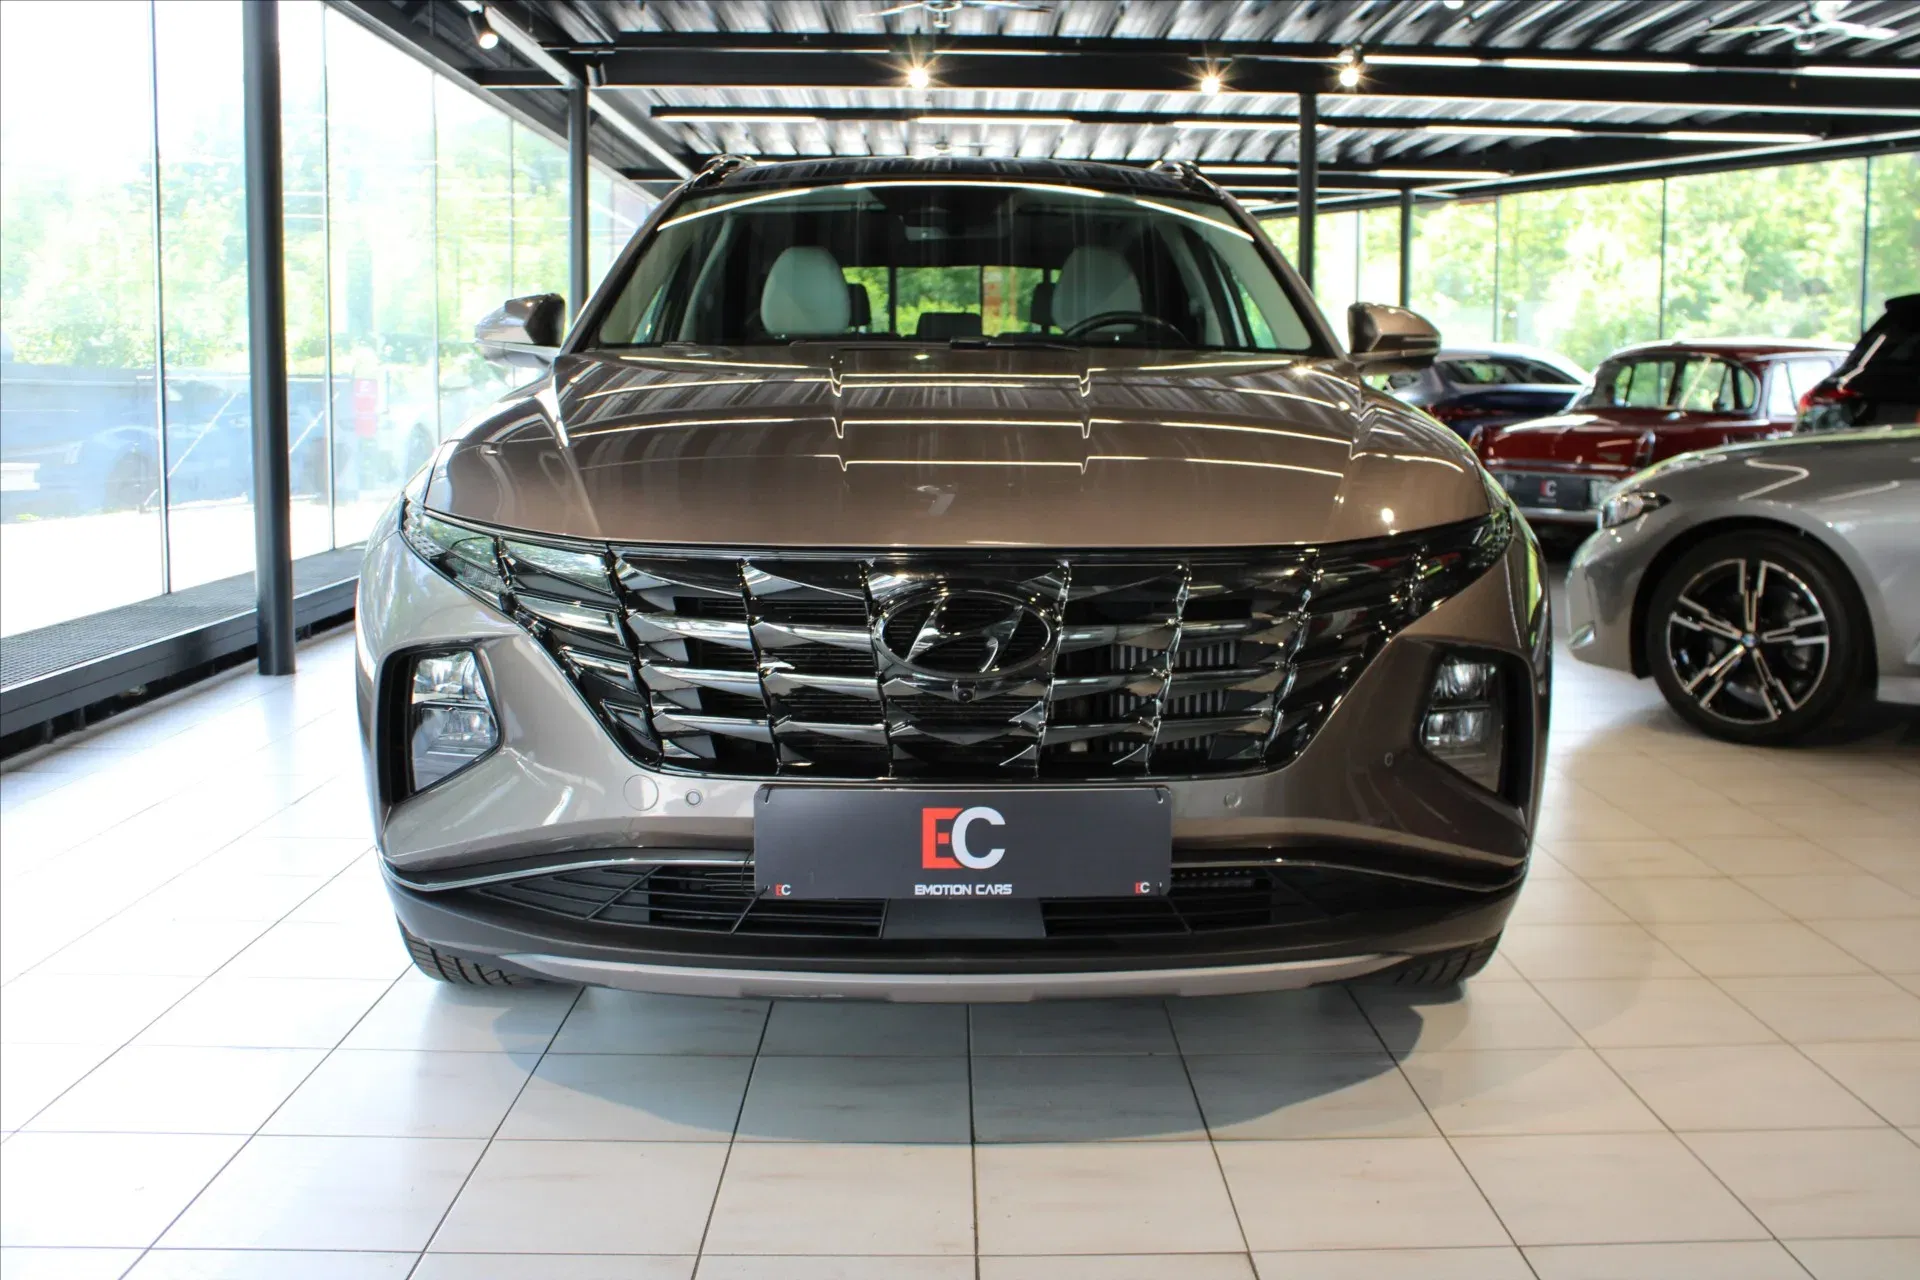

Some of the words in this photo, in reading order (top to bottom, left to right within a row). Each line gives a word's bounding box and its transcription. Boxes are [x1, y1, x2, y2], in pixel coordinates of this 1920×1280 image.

[922, 806, 1006, 870] EC
[775, 884, 791, 896] EC
[914, 884, 972, 896] EMOTION
[975, 884, 1013, 896] CARS
[1135, 882, 1150, 894] EC
